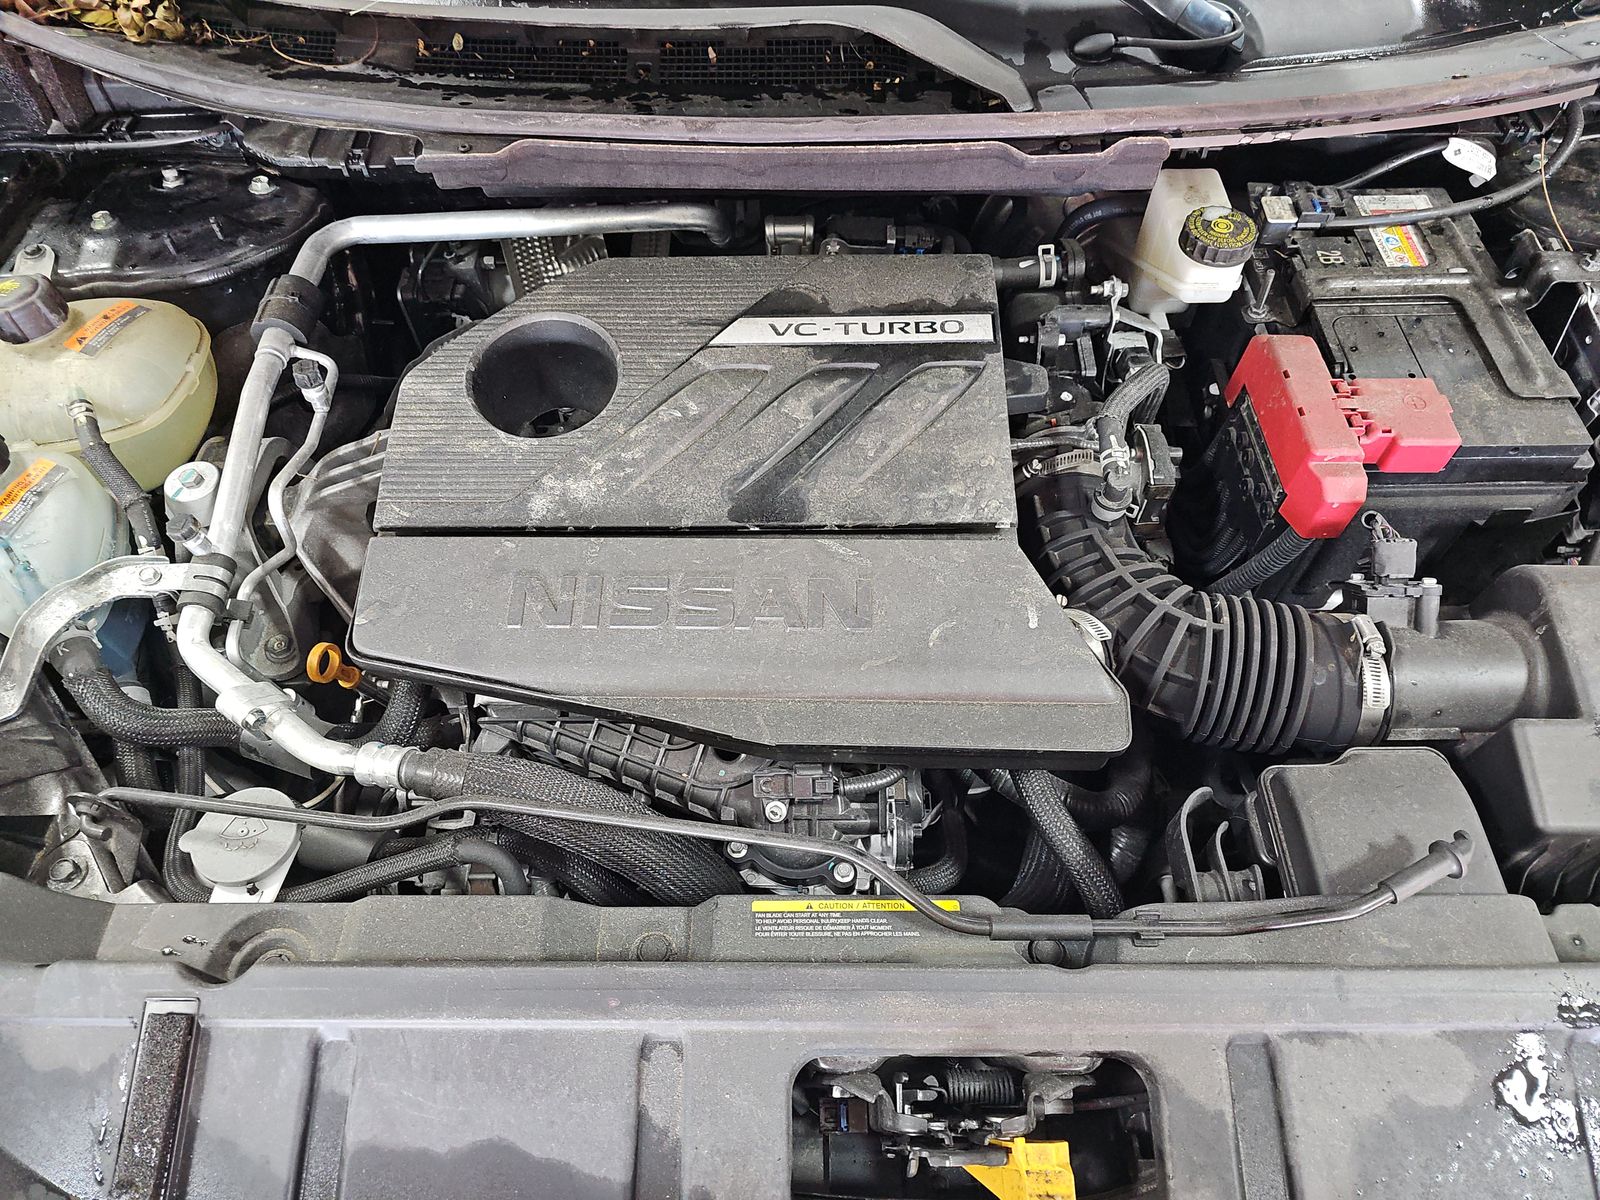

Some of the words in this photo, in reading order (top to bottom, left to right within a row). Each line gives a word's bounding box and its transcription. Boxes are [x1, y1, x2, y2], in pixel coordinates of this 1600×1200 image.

[768, 319, 965, 337] VC-TURBO
[506, 575, 873, 632] NISSAN
[818, 902, 854, 910] CAUTION
[862, 902, 905, 910] ATTENTION
